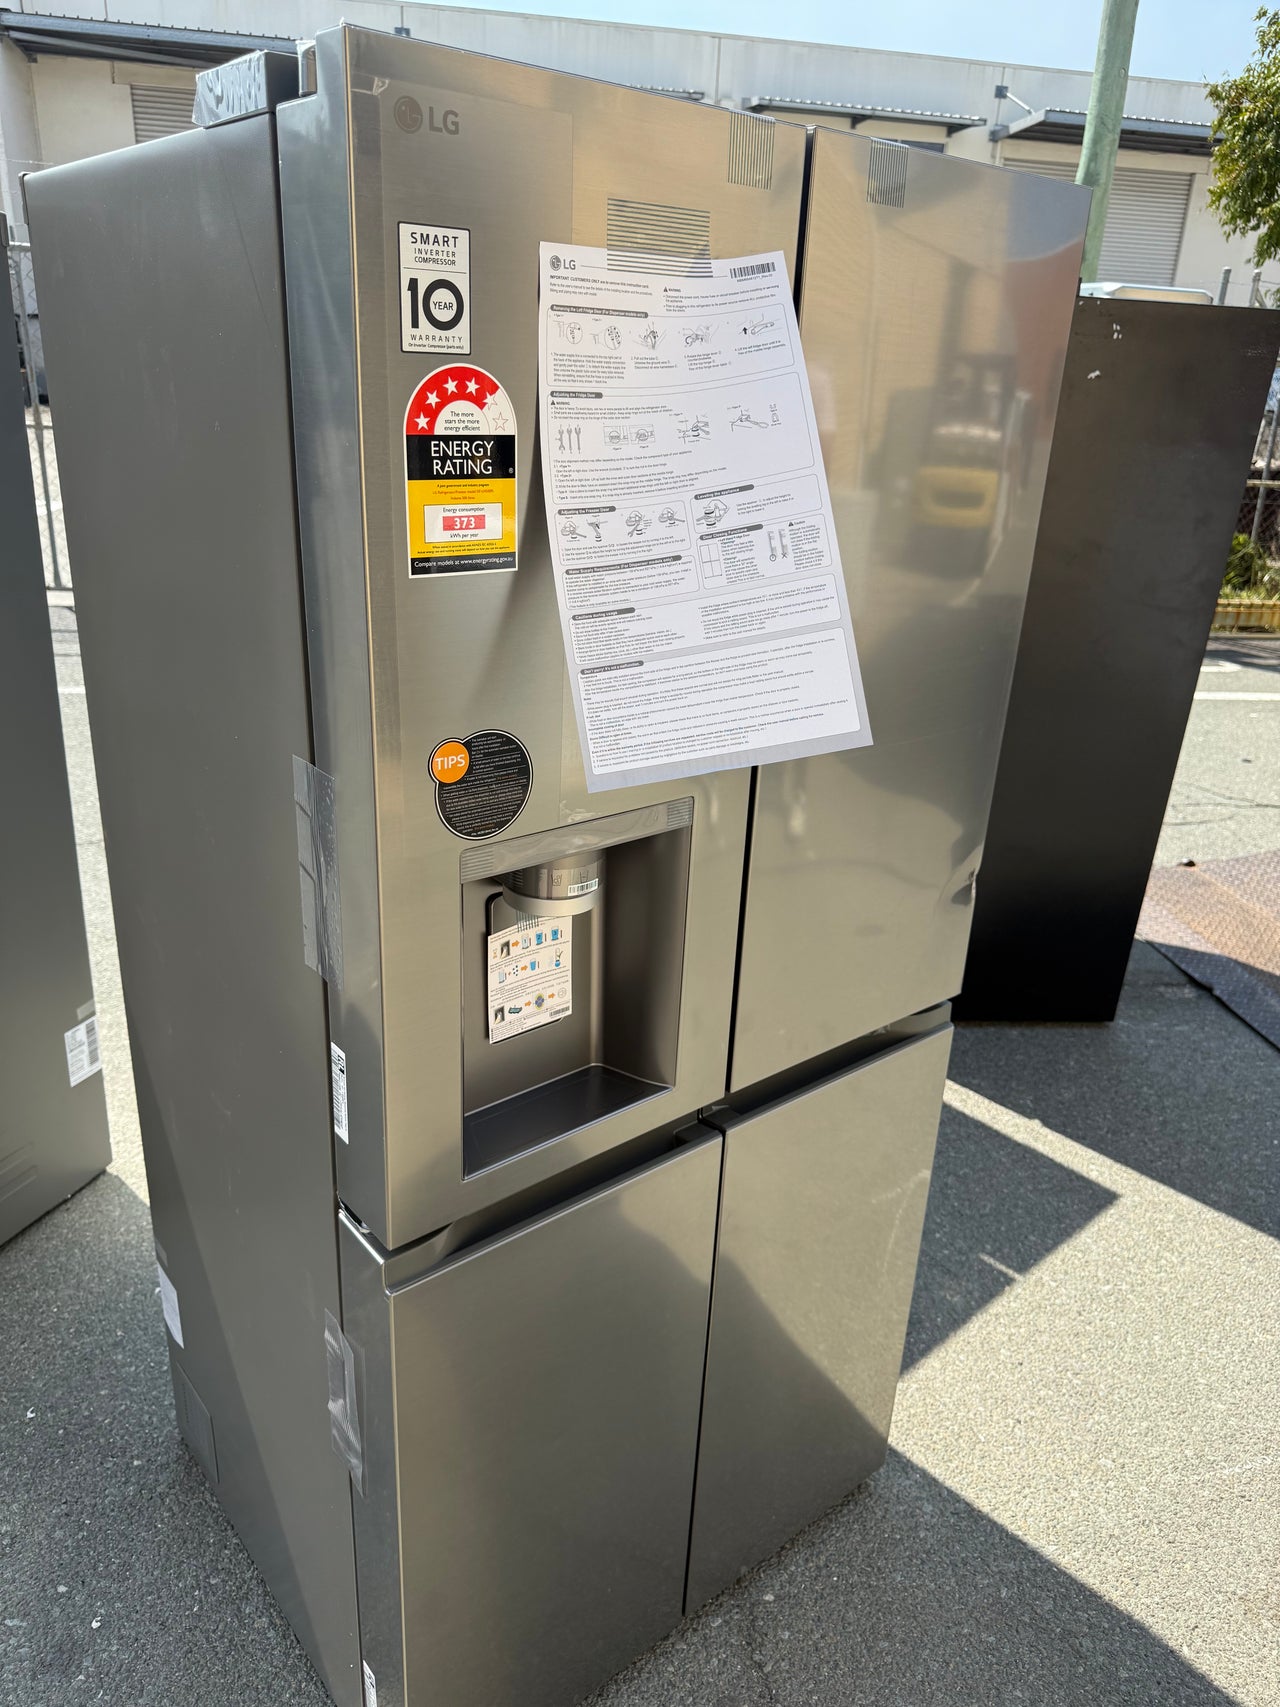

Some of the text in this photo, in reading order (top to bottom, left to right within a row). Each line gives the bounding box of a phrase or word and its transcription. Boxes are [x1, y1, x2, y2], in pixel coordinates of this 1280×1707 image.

[429, 106, 459, 135] LG
[410, 232, 458, 248] SMART
[414, 248, 456, 258] INVERTER
[414, 257, 456, 266] COMPRESSOR
[563, 259, 576, 270] LG
[407, 278, 464, 331] 10
[433, 301, 454, 311] YEAR
[410, 334, 463, 343] WARRANTY
[431, 441, 494, 457] ENERGY
[433, 459, 493, 475] RATING
[443, 506, 459, 514] Energy
[454, 518, 476, 529] 373
[414, 560, 437, 568] Compare
[435, 754, 465, 770] TIPS
